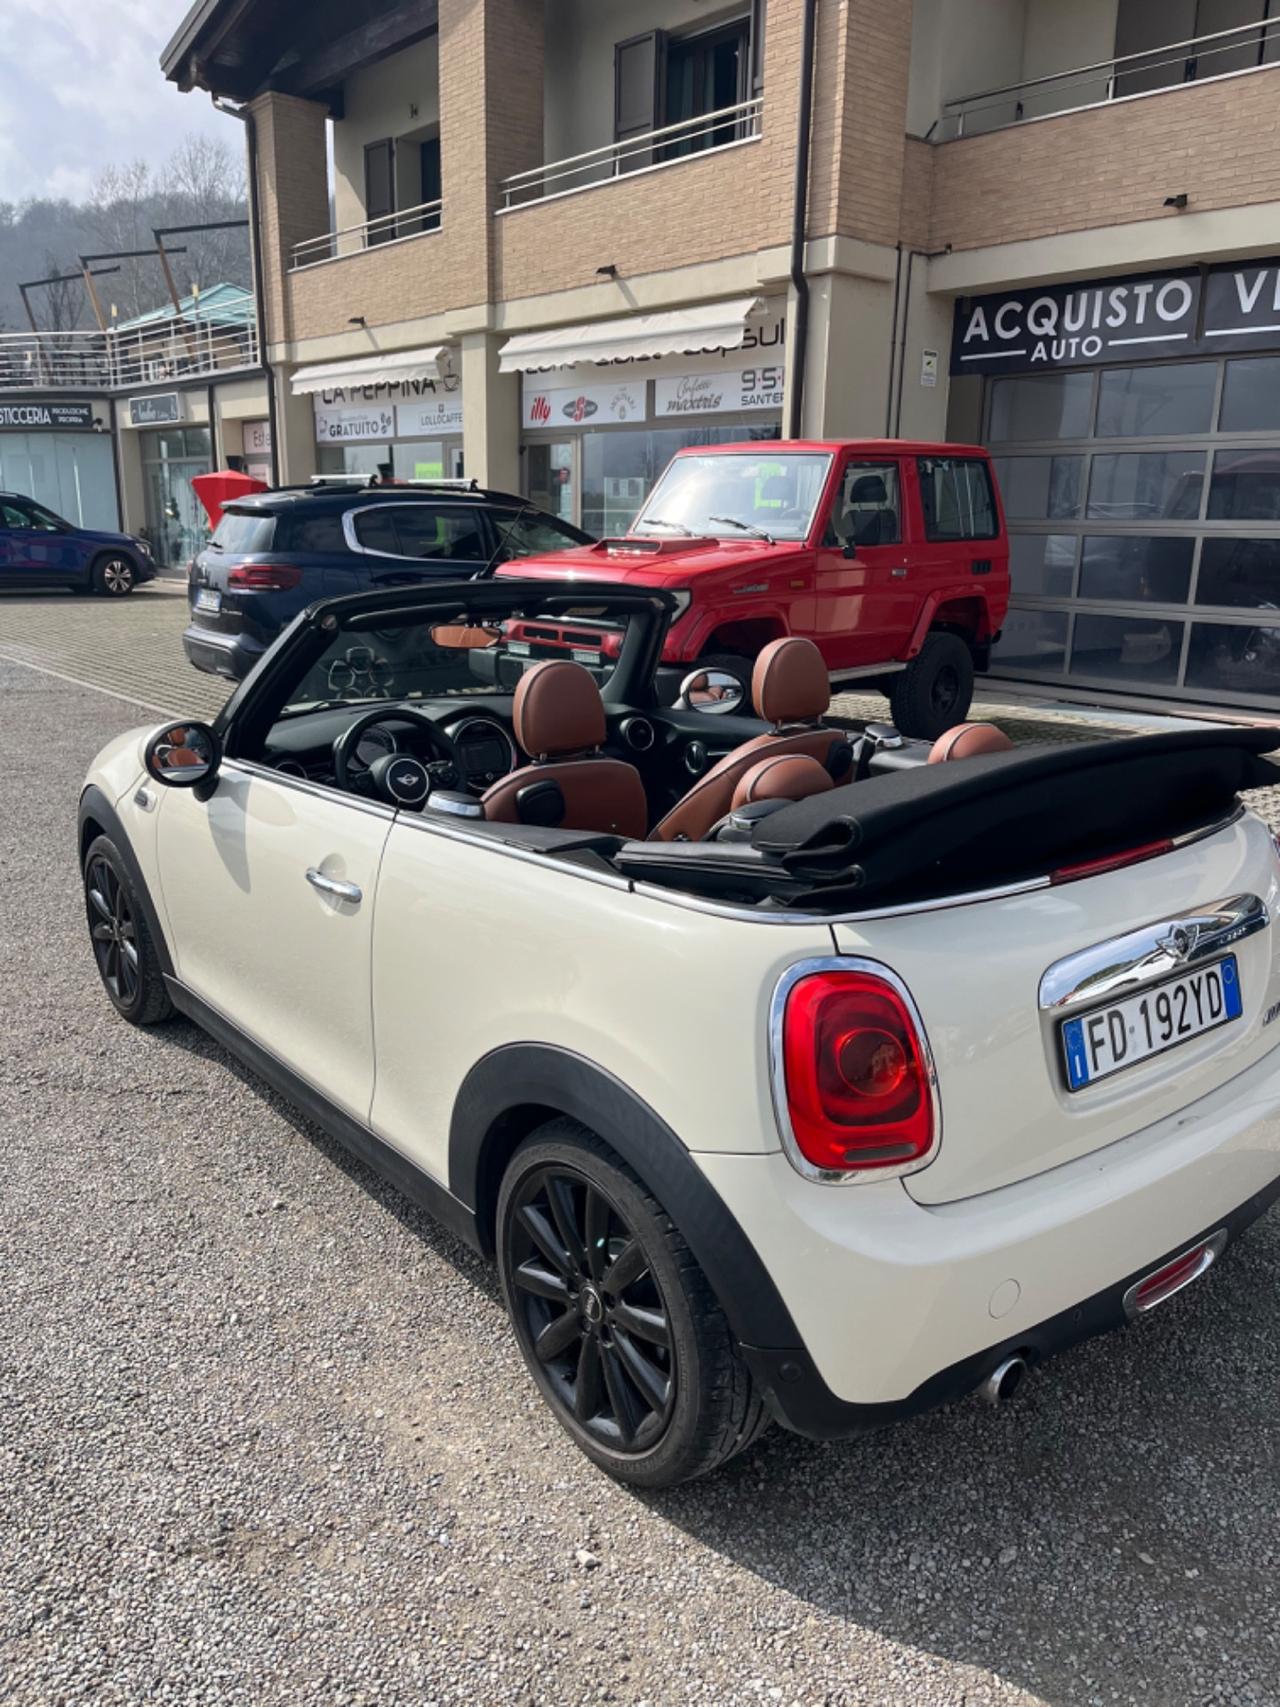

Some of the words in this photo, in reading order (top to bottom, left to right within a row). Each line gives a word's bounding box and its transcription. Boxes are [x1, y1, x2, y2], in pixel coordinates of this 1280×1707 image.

[963, 279, 1193, 344] ACQUISTO
[1031, 335, 1103, 362] AUTO
[322, 387, 346, 404] LA
[350, 377, 436, 402] PEPPINA
[531, 394, 551, 426] illy
[329, 420, 380, 437] GRATUITO
[1086, 1008, 1128, 1072] FD
[1138, 971, 1224, 1050] 192YD
